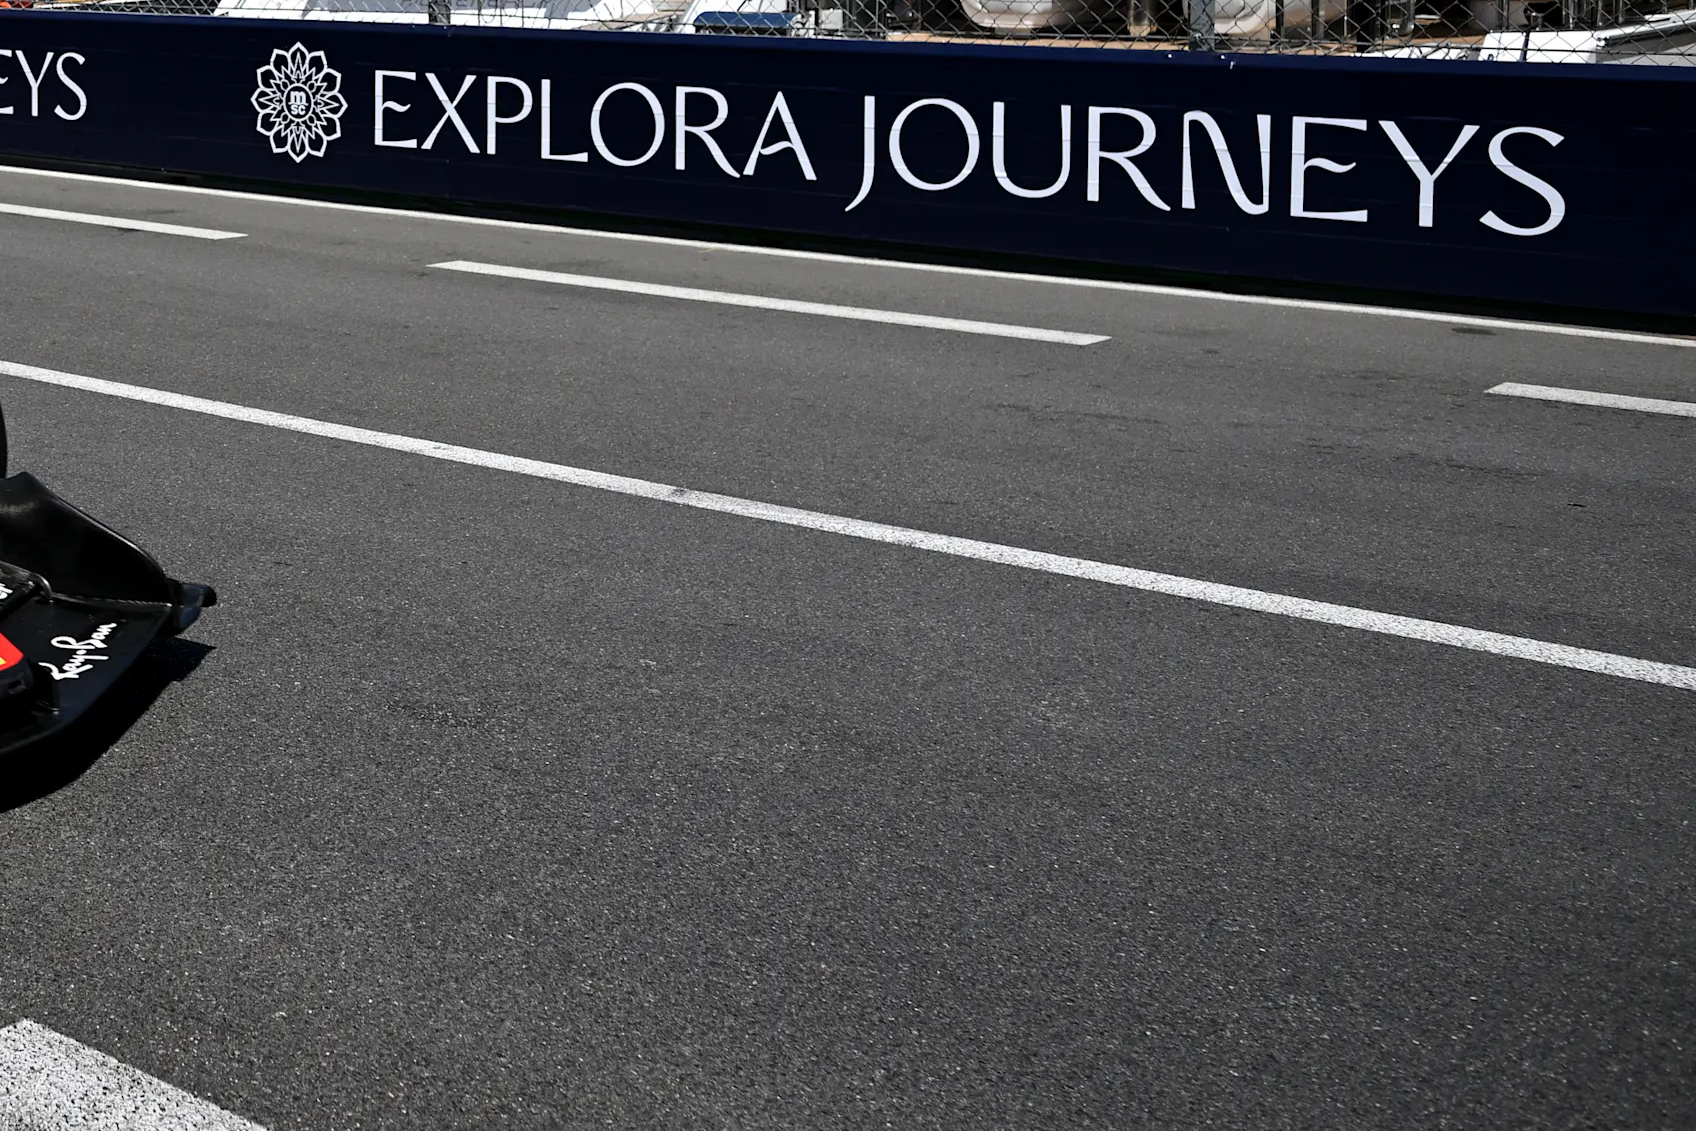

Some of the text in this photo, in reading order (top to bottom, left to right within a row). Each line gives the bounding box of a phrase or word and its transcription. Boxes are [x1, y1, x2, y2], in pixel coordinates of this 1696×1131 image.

[373, 69, 1567, 237] EXPLORA JOURNEYS
[37, 622, 118, 681] Ray-Ban
